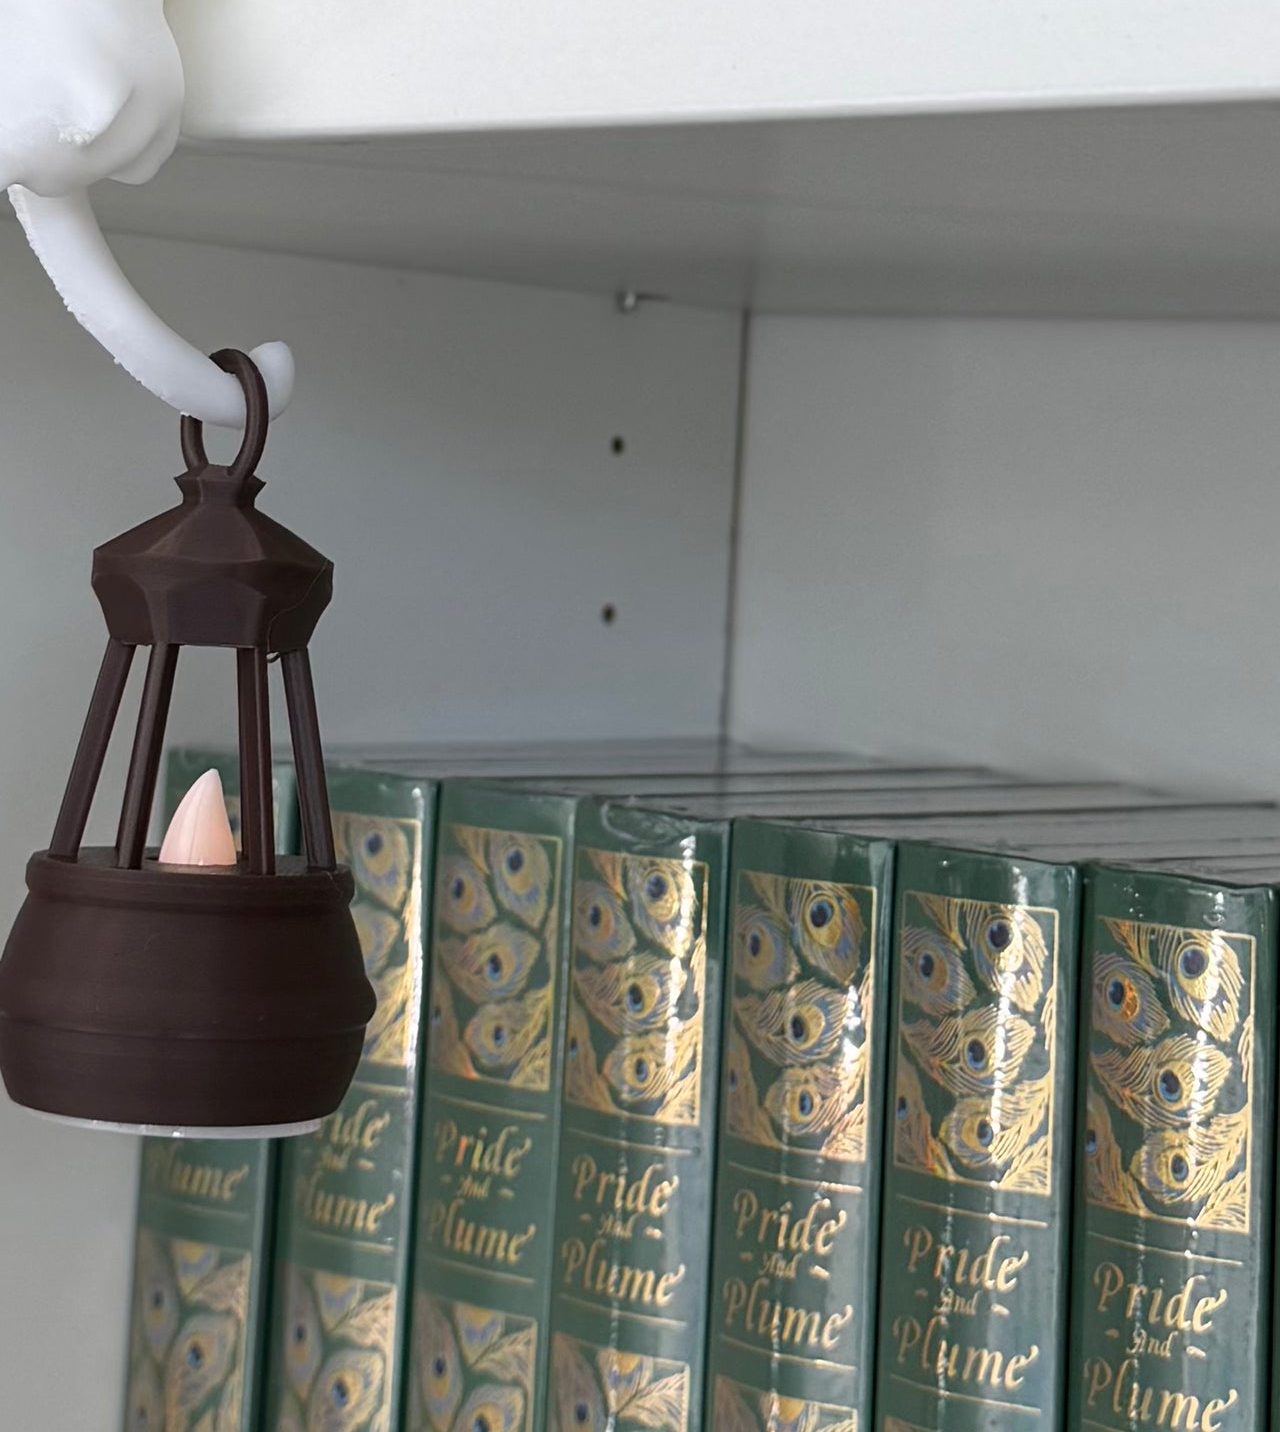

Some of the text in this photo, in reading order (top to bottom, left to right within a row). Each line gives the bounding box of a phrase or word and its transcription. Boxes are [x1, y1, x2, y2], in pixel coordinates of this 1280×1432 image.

[316, 1099, 391, 1151] ride
[434, 1119, 533, 1179] Pride
[571, 1154, 679, 1217] Pride
[423, 1198, 537, 1266] Plume
[598, 1212, 639, 1240] And
[733, 1189, 847, 1257] Pride
[560, 1237, 686, 1307] Plume
[761, 1252, 803, 1279] And
[903, 1225, 1029, 1293] Pride
[723, 1276, 854, 1350] Plume
[934, 1287, 981, 1316] And
[1093, 1261, 1228, 1333] Pride
[892, 1314, 1040, 1390] Plume
[1126, 1329, 1177, 1359] And
